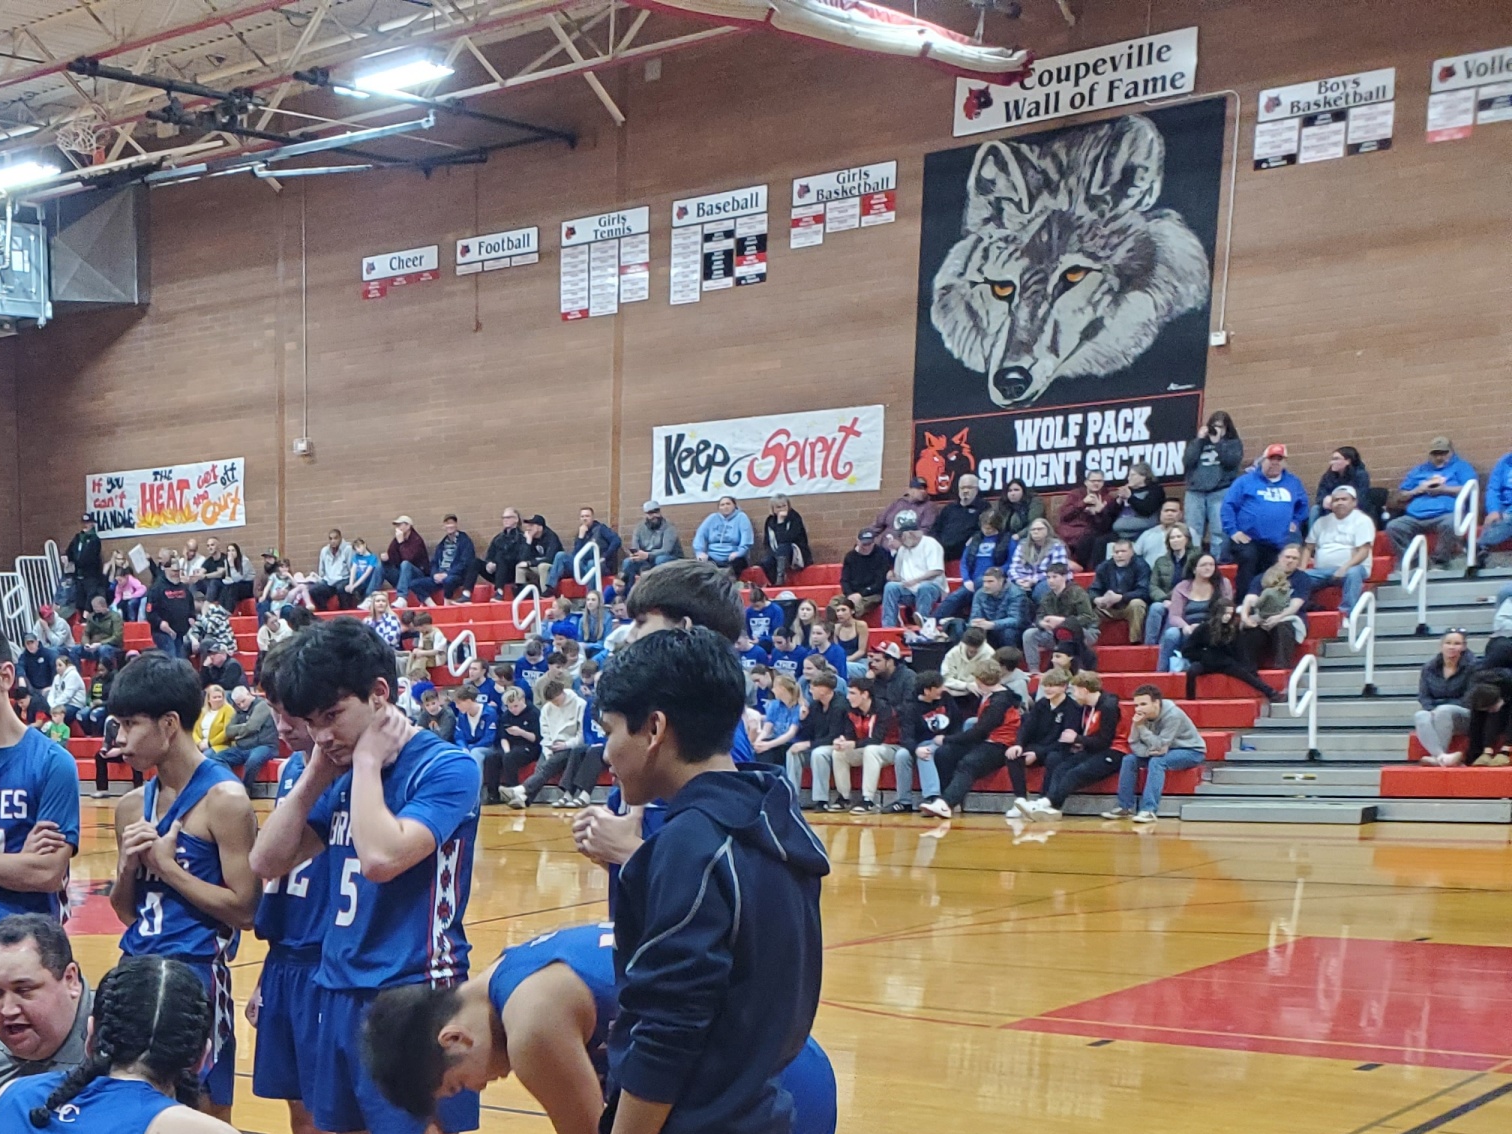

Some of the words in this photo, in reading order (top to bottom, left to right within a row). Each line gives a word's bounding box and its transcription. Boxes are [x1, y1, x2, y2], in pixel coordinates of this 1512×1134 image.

[1004, 90, 1060, 121] Wall
[1069, 82, 1099, 109] of
[1107, 71, 1186, 103] Fame
[1317, 76, 1361, 95] Boys
[1289, 85, 1386, 115] Basketball
[816, 176, 890, 201] Basketball
[836, 168, 870, 185] Girls
[696, 192, 759, 218] Baseball
[593, 223, 632, 239] Tennis
[598, 214, 626, 228] Girls
[478, 233, 530, 255] Football
[389, 253, 425, 271] Cheer
[1014, 413, 1083, 452] WOLF
[1086, 406, 1152, 446] PACK
[665, 433, 730, 496] Keep
[746, 417, 862, 488] Spirit
[978, 451, 1082, 491] STUDENT
[1085, 441, 1186, 481] SECTION
[153, 469, 173, 481] THE
[140, 479, 190, 516] HEAT
[335, 857, 361, 927] 5
